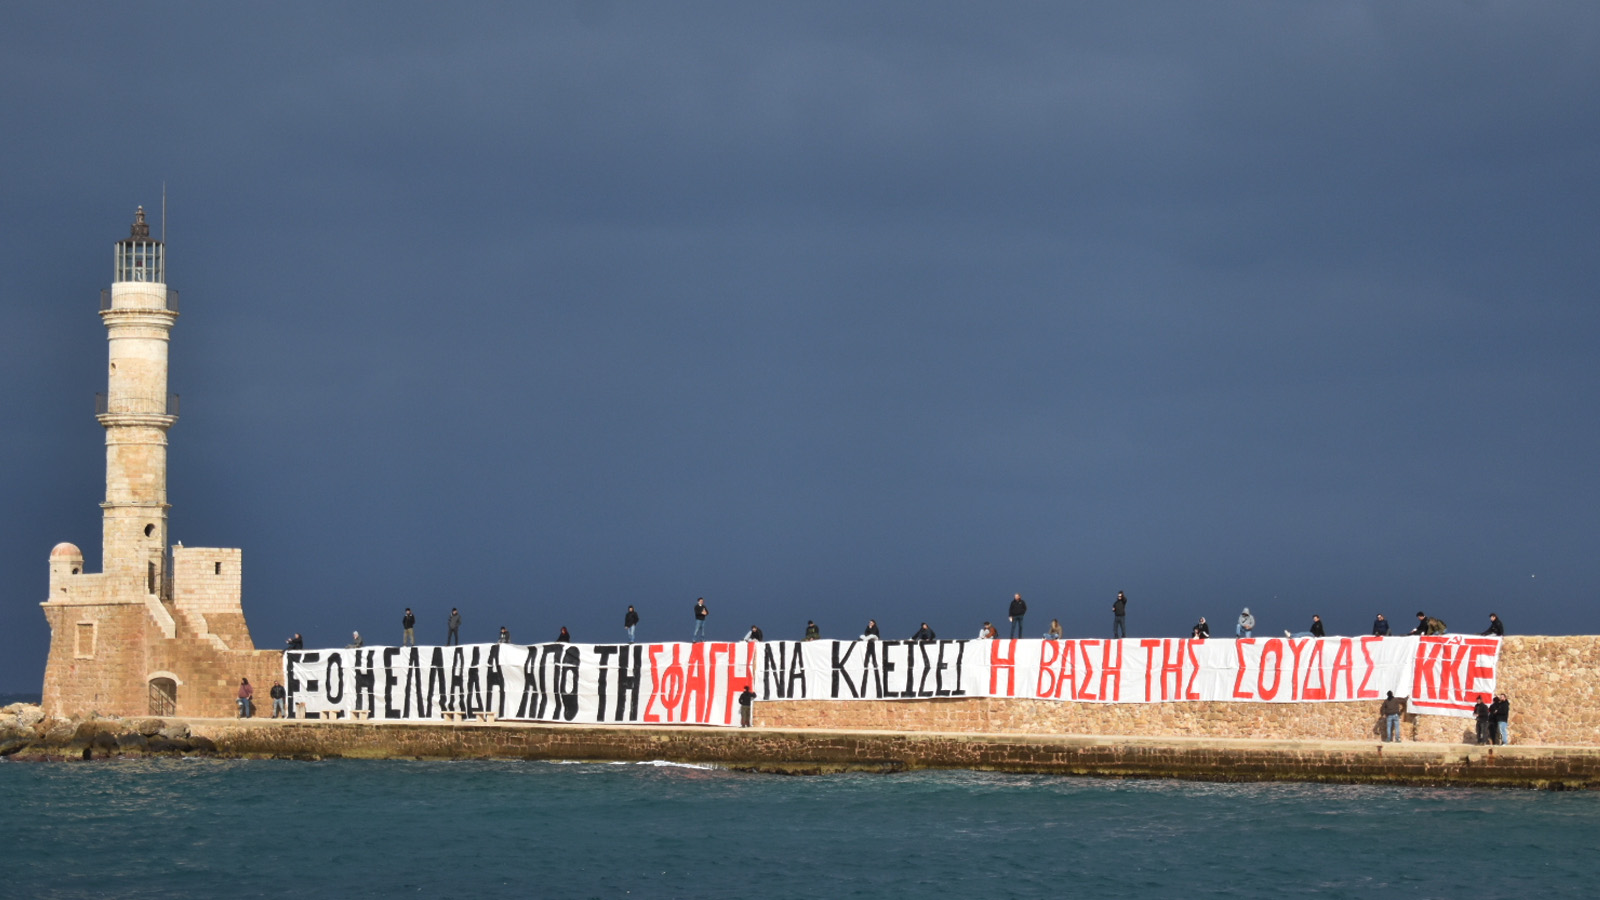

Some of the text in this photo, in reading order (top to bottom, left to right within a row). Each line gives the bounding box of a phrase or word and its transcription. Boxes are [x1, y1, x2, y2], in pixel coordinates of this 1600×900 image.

[355, 649, 375, 718] Η
[383, 645, 505, 719] ΕΛΛΑΔΑ
[516, 644, 580, 721] ΑΠΟ
[594, 645, 642, 722] ΤΗ
[644, 642, 755, 724] ΣΦΑΓΗ
[763, 636, 1383, 702] ΝΑ ΚΛΕΙΣΕΙ Η ΒΑΣΗ ΤΗΣ ΣΟΥΔΑΣ
[1412, 643, 1497, 704] ΚΚΕ
